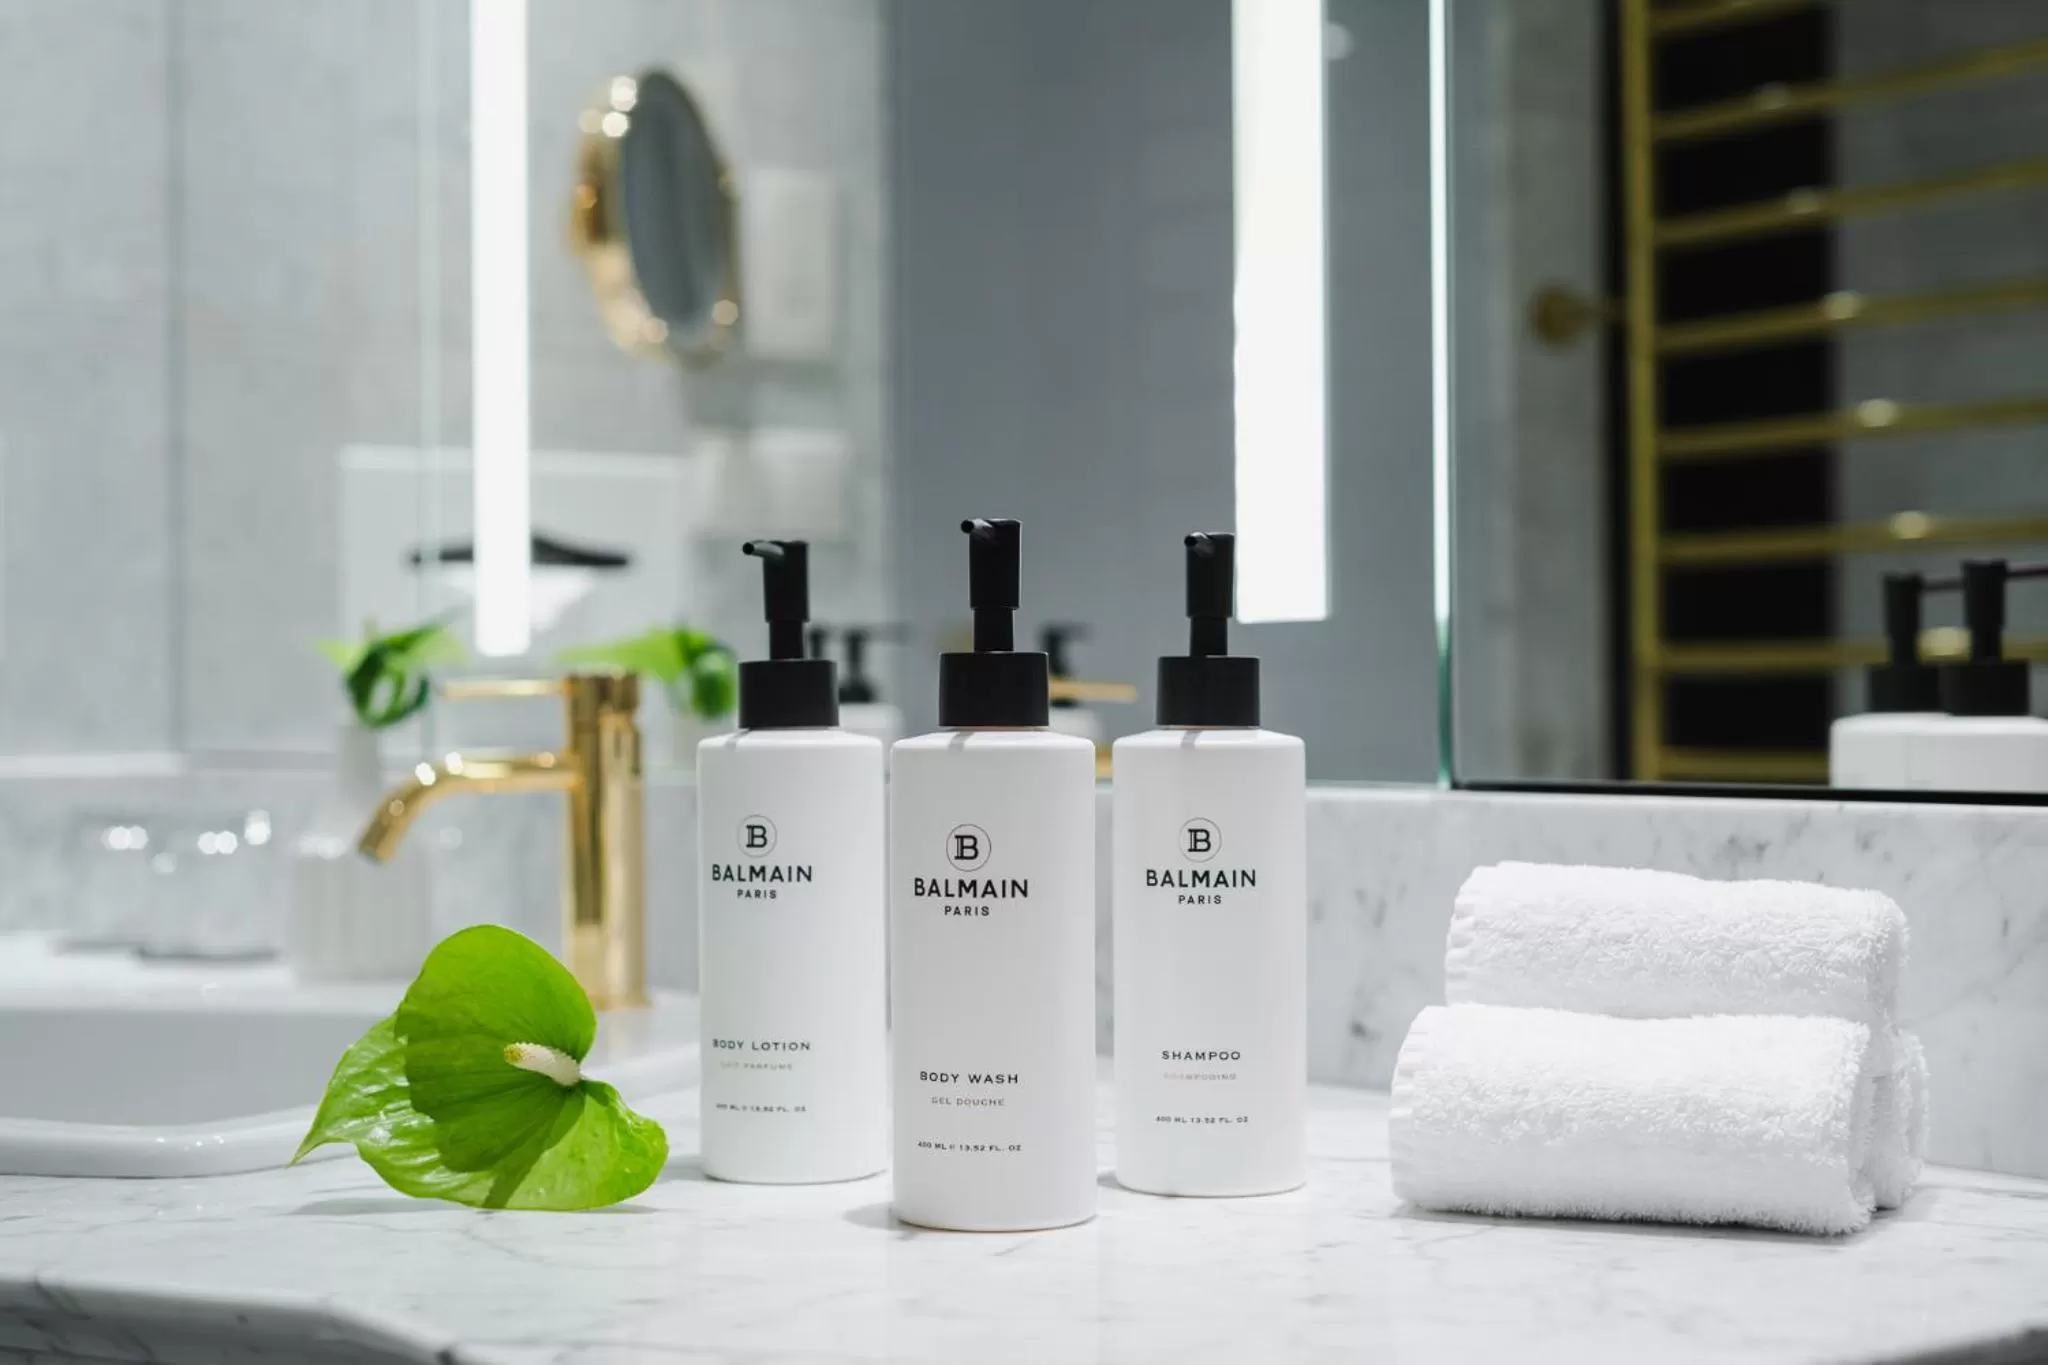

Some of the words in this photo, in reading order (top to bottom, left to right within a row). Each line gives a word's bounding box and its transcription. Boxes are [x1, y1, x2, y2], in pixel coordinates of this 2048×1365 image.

[746, 824, 768, 848] B
[1187, 828, 1212, 852] B
[954, 834, 979, 860] B
[711, 863, 812, 883] BALMAIN
[1145, 869, 1256, 888] BALMAIN
[737, 889, 777, 899] PARIS
[914, 877, 1028, 899] BALMAIN
[1178, 895, 1222, 905] PARIS
[944, 905, 990, 917] PARIS
[712, 1038, 745, 1050] BODY
[751, 1041, 811, 1051] LOTION
[1161, 1050, 1241, 1061] SHAMPOO
[919, 1071, 960, 1083] BODY
[968, 1073, 1019, 1084] WASH
[956, 1098, 1005, 1107] DOUCHE
